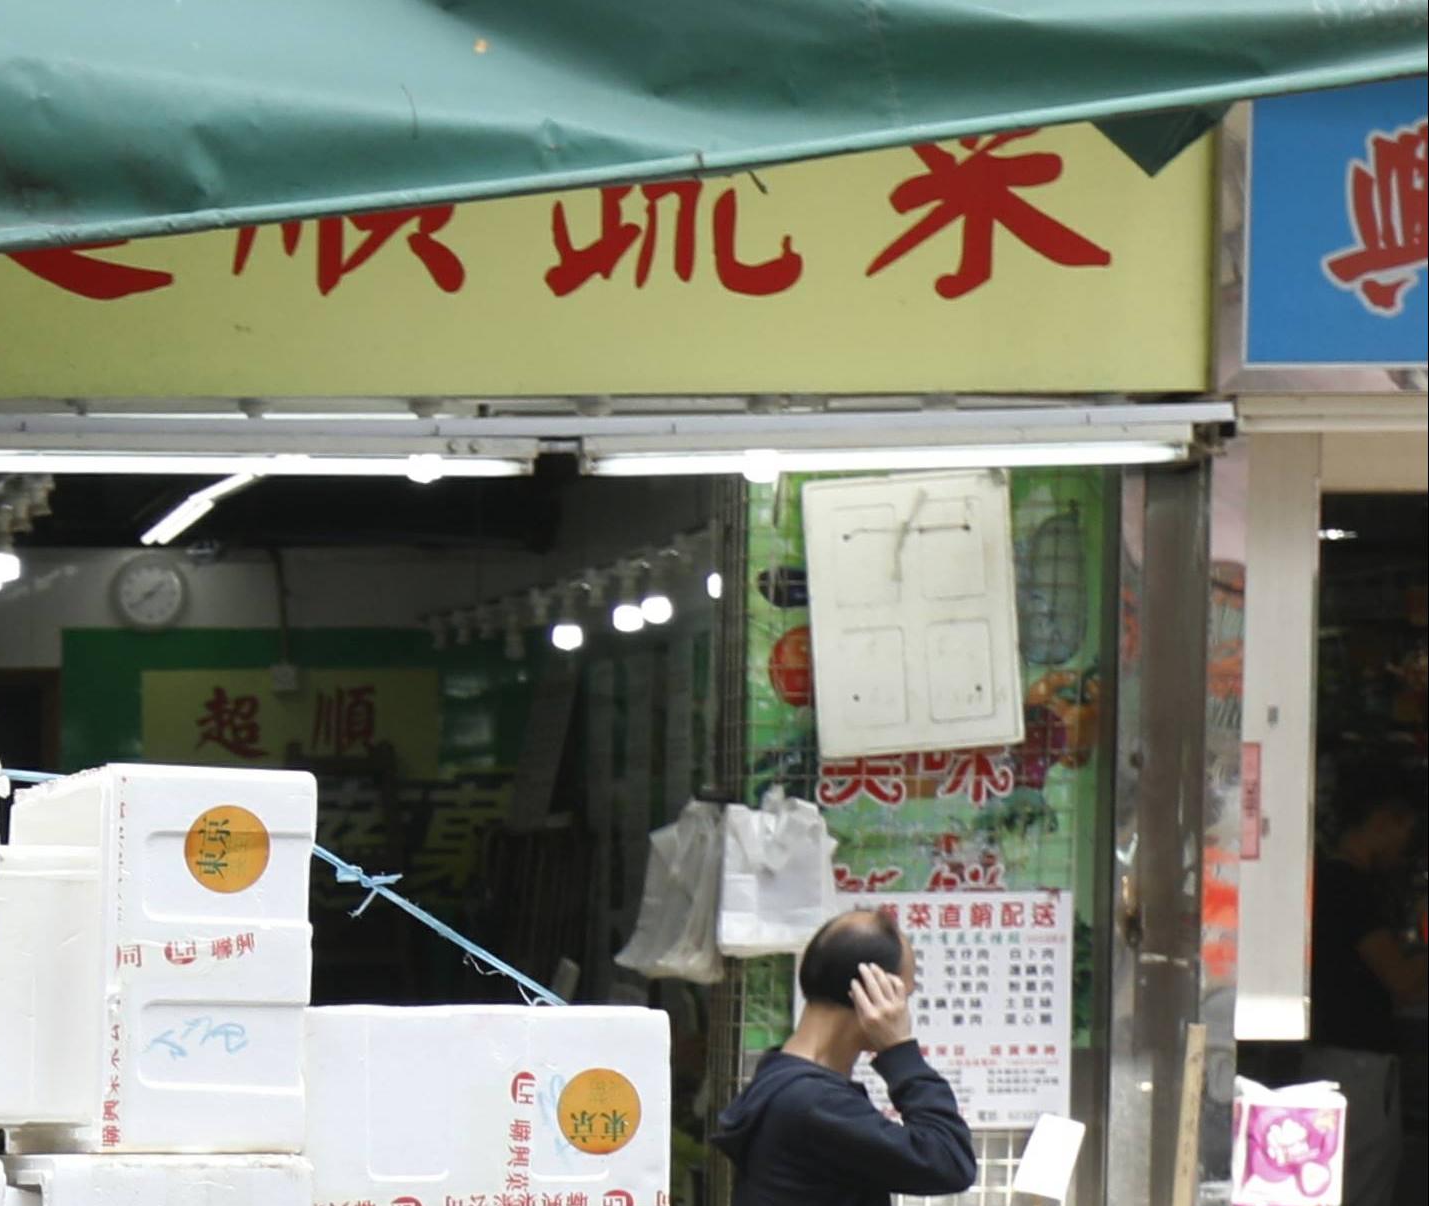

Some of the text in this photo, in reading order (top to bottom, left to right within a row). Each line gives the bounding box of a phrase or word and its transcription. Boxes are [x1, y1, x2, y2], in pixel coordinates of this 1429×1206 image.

[195, 684, 379, 759] 超順
[196, 816, 231, 880] 東京
[570, 1109, 628, 1143] 東京
